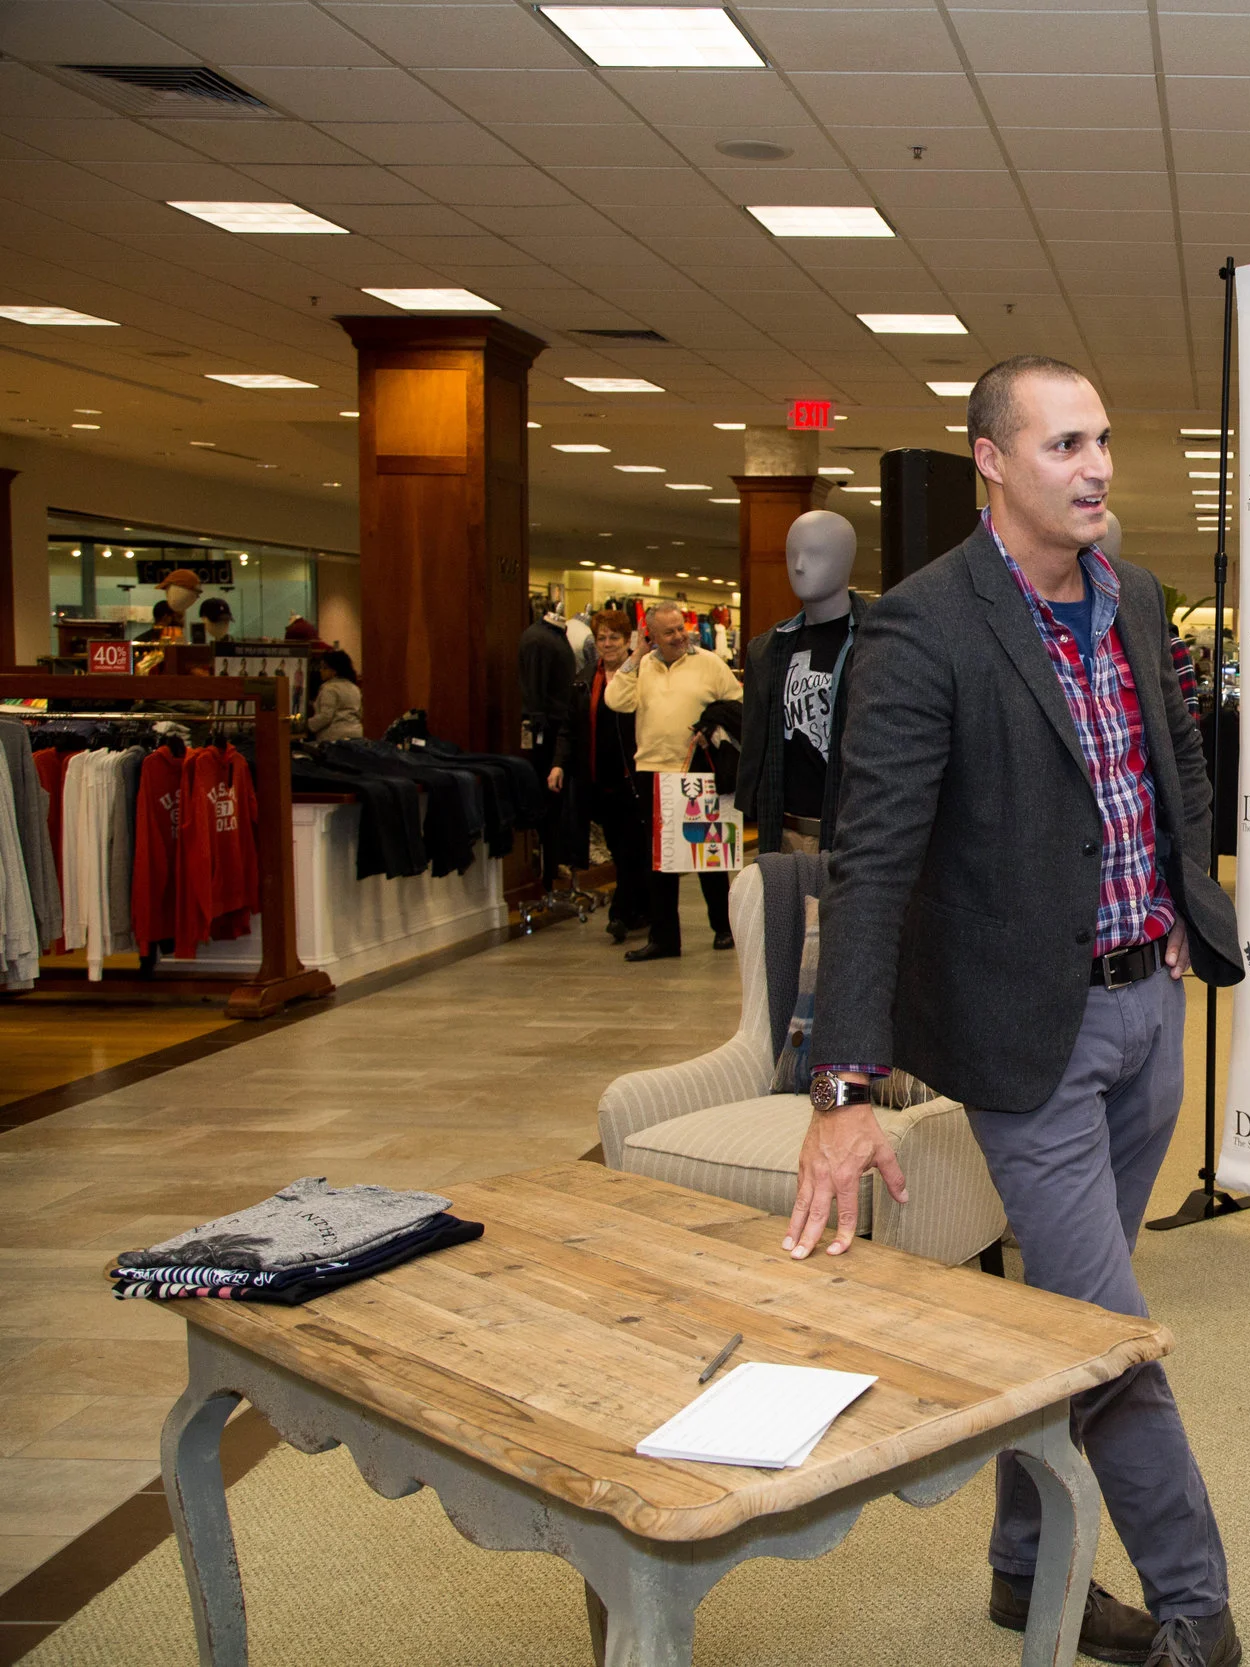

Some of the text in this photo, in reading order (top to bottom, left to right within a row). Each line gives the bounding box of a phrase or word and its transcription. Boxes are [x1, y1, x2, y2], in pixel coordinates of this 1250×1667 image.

[795, 401, 831, 426] EXIT
[786, 663, 830, 704] Texas
[661, 774, 676, 871] NORDSTROM
